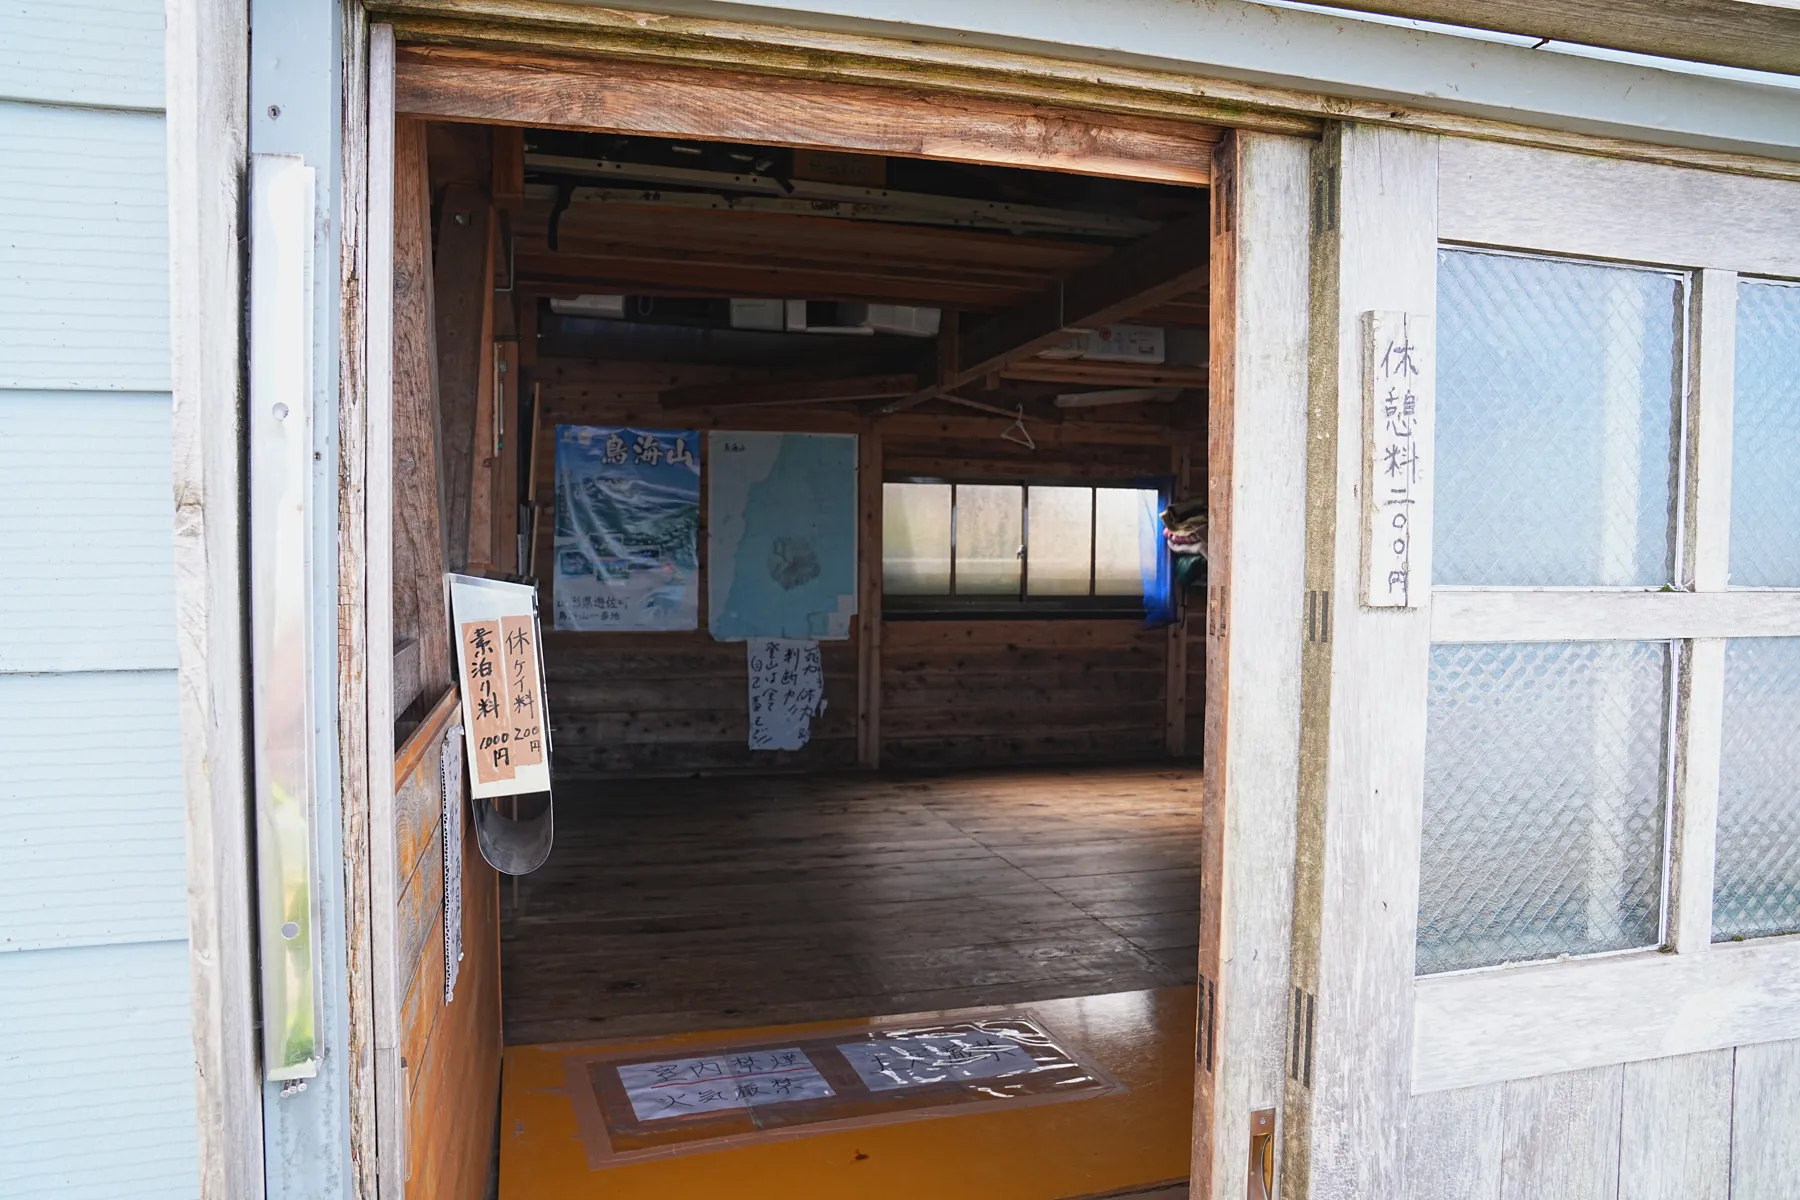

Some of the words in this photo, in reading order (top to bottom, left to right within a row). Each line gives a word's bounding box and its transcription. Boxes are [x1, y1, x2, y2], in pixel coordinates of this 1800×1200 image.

[602, 433, 695, 466] 鳥海山
[469, 627, 499, 720] 素泊り料
[505, 627, 534, 719] 休ケイ料
[648, 1051, 810, 1083] 室内禁煙
[659, 1077, 805, 1110] 火気厳禁
